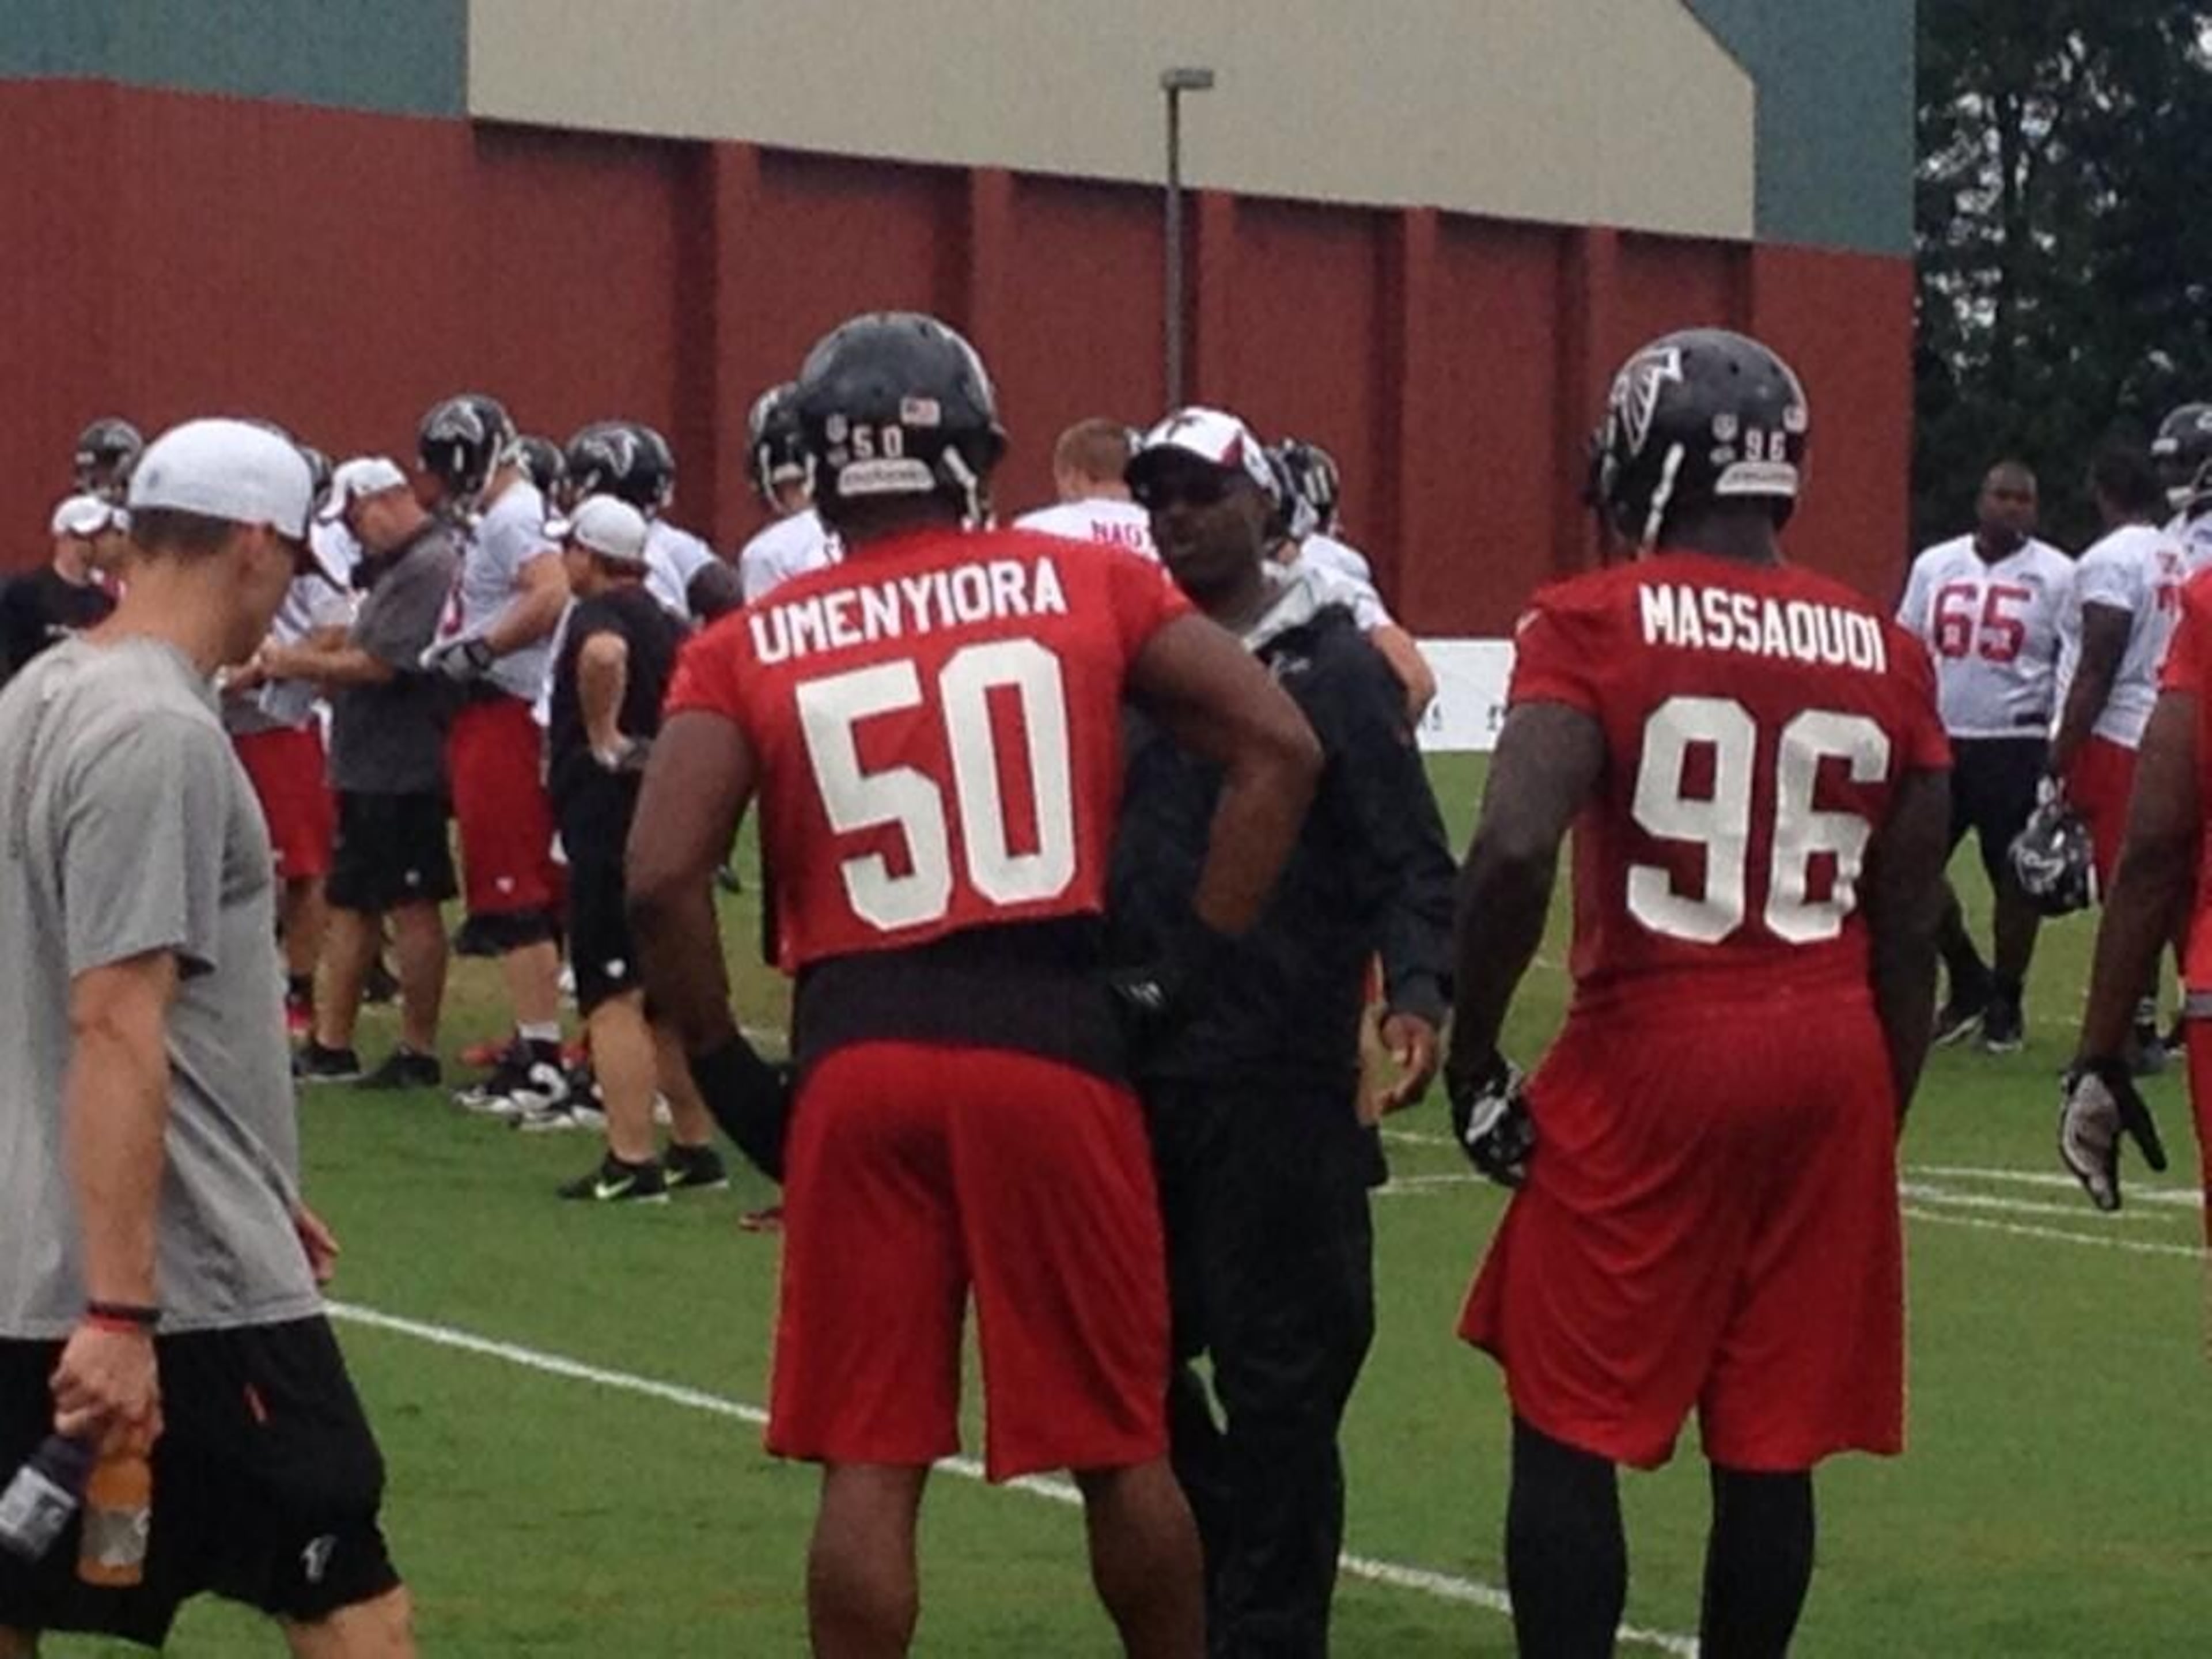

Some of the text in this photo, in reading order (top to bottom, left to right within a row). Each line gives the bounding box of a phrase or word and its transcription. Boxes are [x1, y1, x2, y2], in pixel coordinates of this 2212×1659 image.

[853, 425, 903, 459] 50
[1745, 427, 1785, 461] 96
[751, 556, 1067, 664] UMENYIORA
[1639, 583, 1886, 673] MASSAQUOI
[1933, 583, 2031, 662] 65
[796, 638, 1075, 932] 50
[1626, 696, 1890, 945] 96
